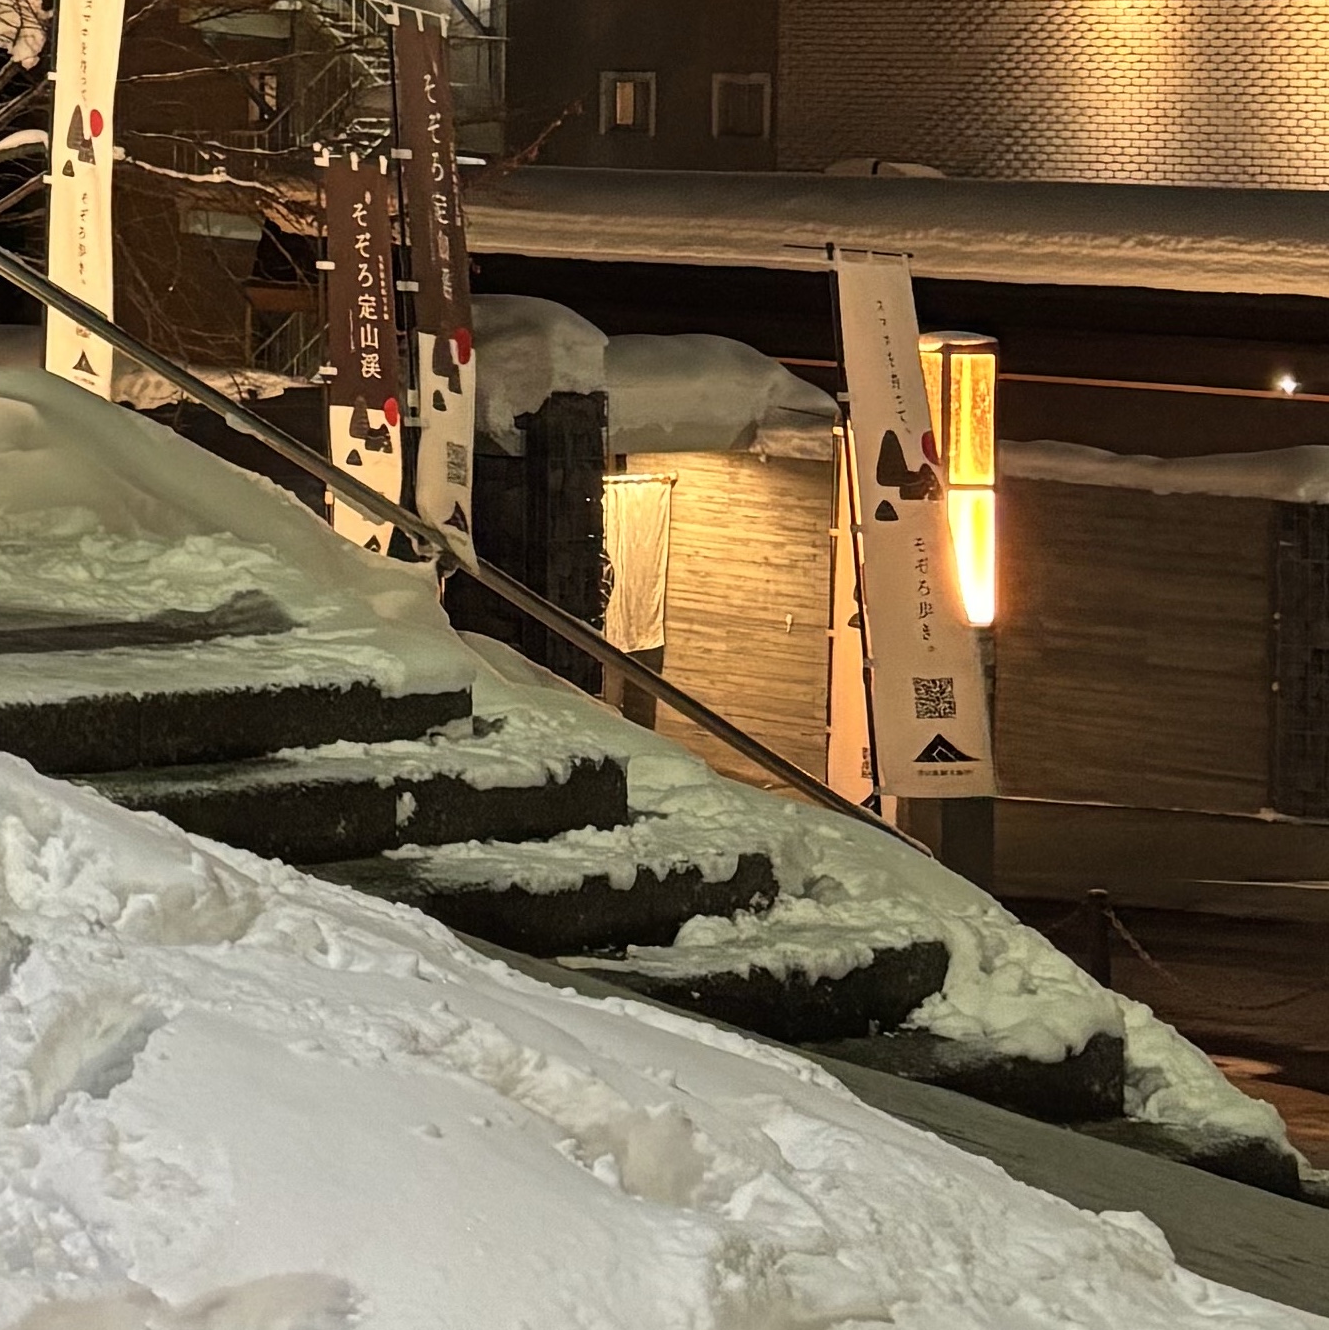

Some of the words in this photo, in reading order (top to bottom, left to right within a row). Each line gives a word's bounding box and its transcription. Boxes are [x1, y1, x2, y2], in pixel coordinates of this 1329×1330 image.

[424, 73, 454, 301] そぞろ定
[351, 202, 383, 380] そぞろ定山渓
